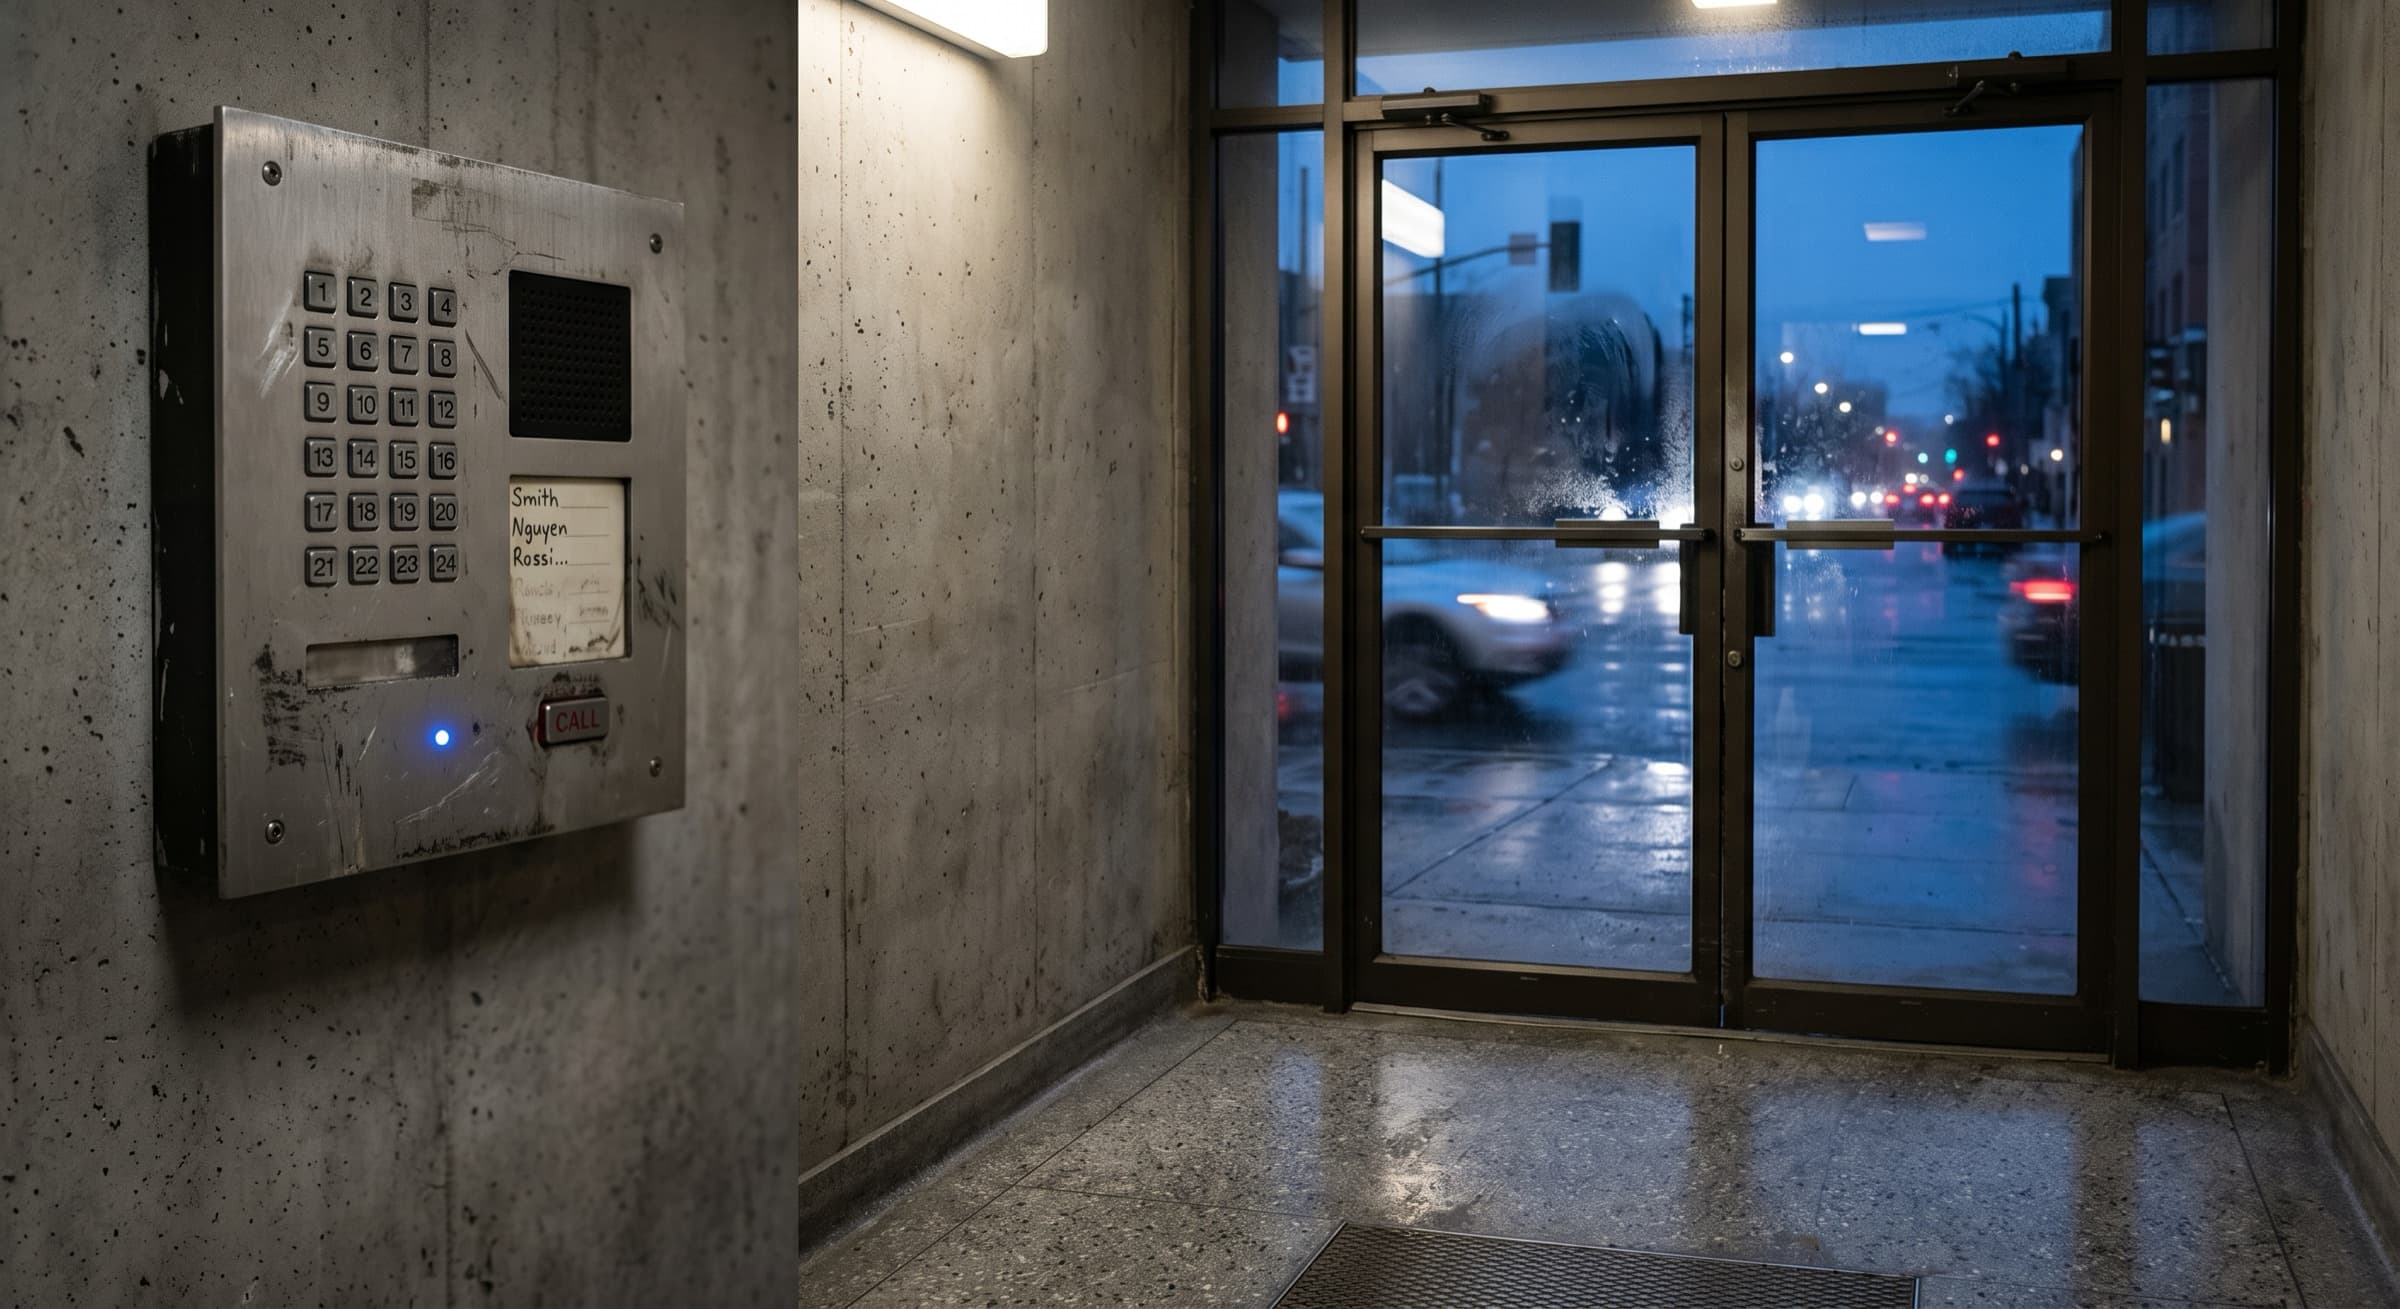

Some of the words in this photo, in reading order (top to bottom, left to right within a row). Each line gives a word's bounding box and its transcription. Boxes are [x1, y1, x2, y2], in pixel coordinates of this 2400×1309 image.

[318, 282, 326, 301] 1
[360, 287, 372, 306] 2
[400, 292, 412, 311] 3
[441, 298, 451, 316] 4
[317, 337, 329, 357] 5
[360, 342, 372, 360] 6
[401, 345, 412, 363] 7
[441, 349, 451, 367] 8
[317, 392, 329, 412] 9
[357, 395, 376, 414] 10
[399, 398, 414, 416] 11
[437, 400, 454, 418] 12
[314, 447, 333, 467] 13
[356, 449, 376, 468] 14
[397, 450, 416, 469] 15
[437, 451, 455, 470] 16
[512, 486, 559, 508] Smith
[314, 502, 334, 522] 17
[357, 502, 376, 521] 18
[397, 502, 416, 521] 19
[435, 502, 456, 521] 20
[512, 517, 568, 544] Nguyen
[355, 556, 378, 575] 22
[396, 555, 418, 574] 23
[436, 554, 456, 573] 24
[513, 546, 568, 567] Rossi...
[314, 557, 333, 577] 21
[556, 708, 600, 733] CALL
